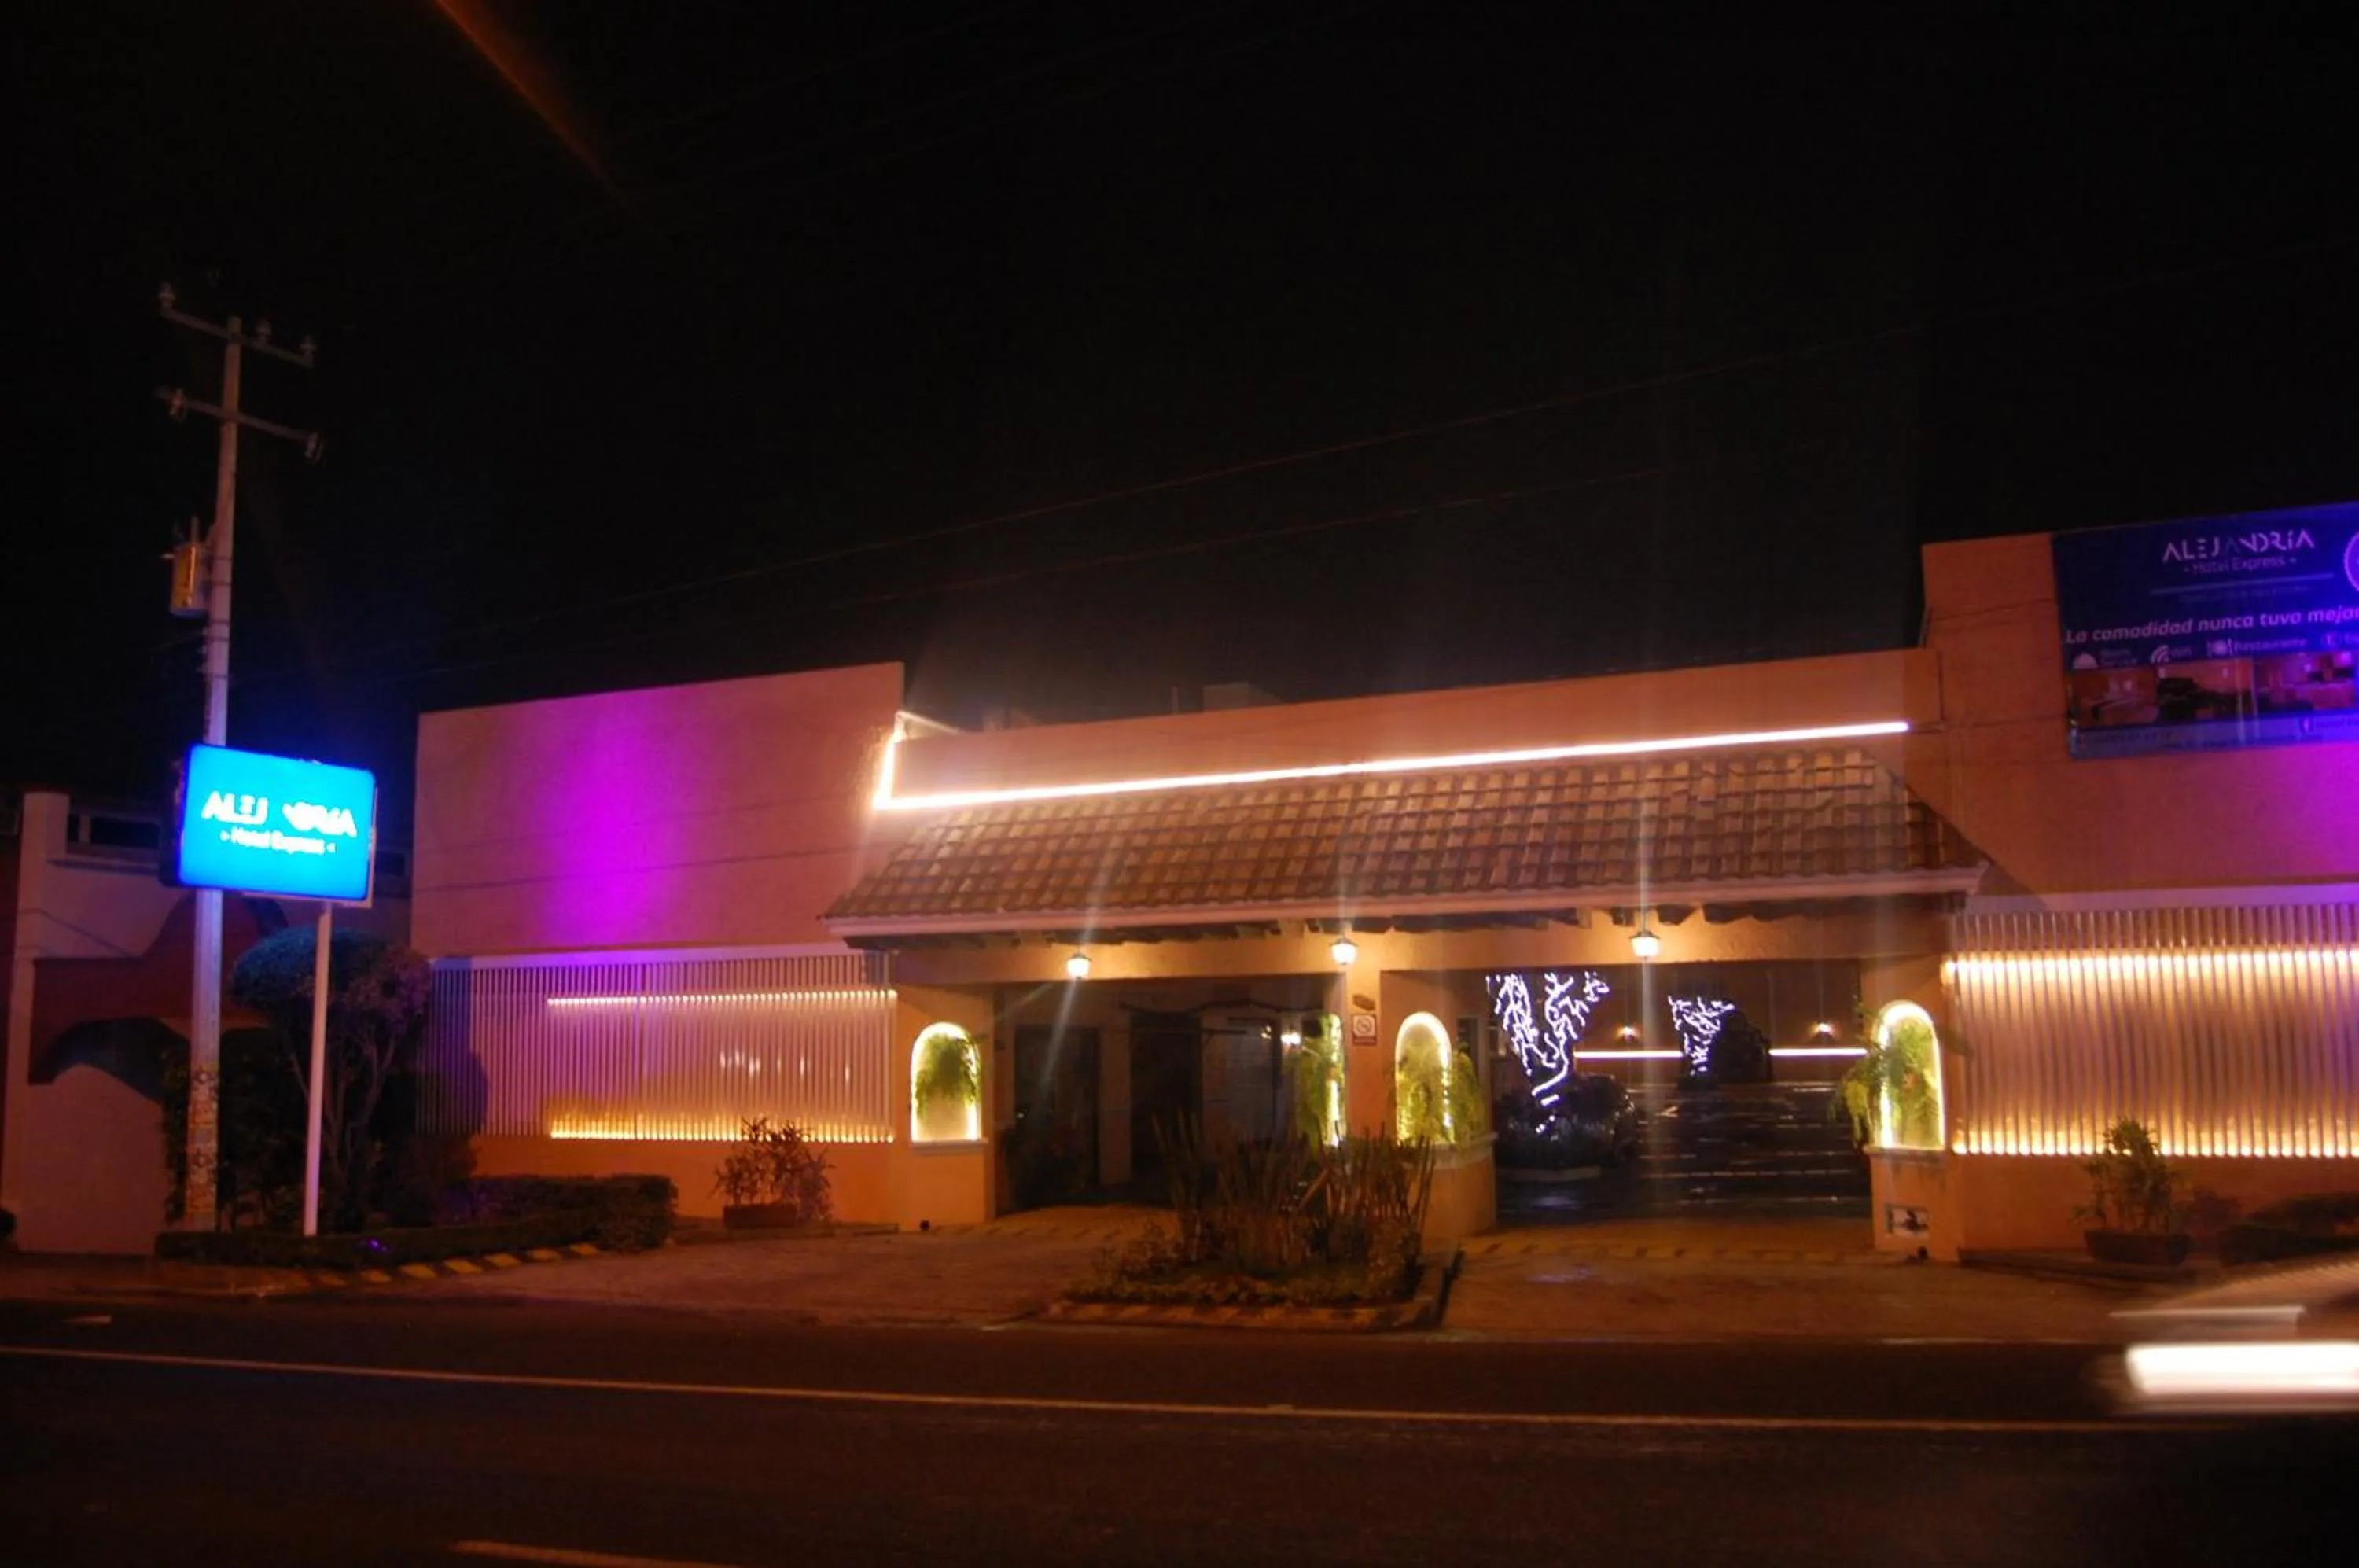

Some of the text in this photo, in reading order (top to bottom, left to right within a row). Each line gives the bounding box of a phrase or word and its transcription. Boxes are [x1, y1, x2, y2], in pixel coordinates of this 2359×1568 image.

[2066, 629, 2087, 644] La
[2092, 619, 2193, 640] comodidad
[2198, 614, 2254, 632] nunca
[2259, 609, 2303, 628] tuvo
